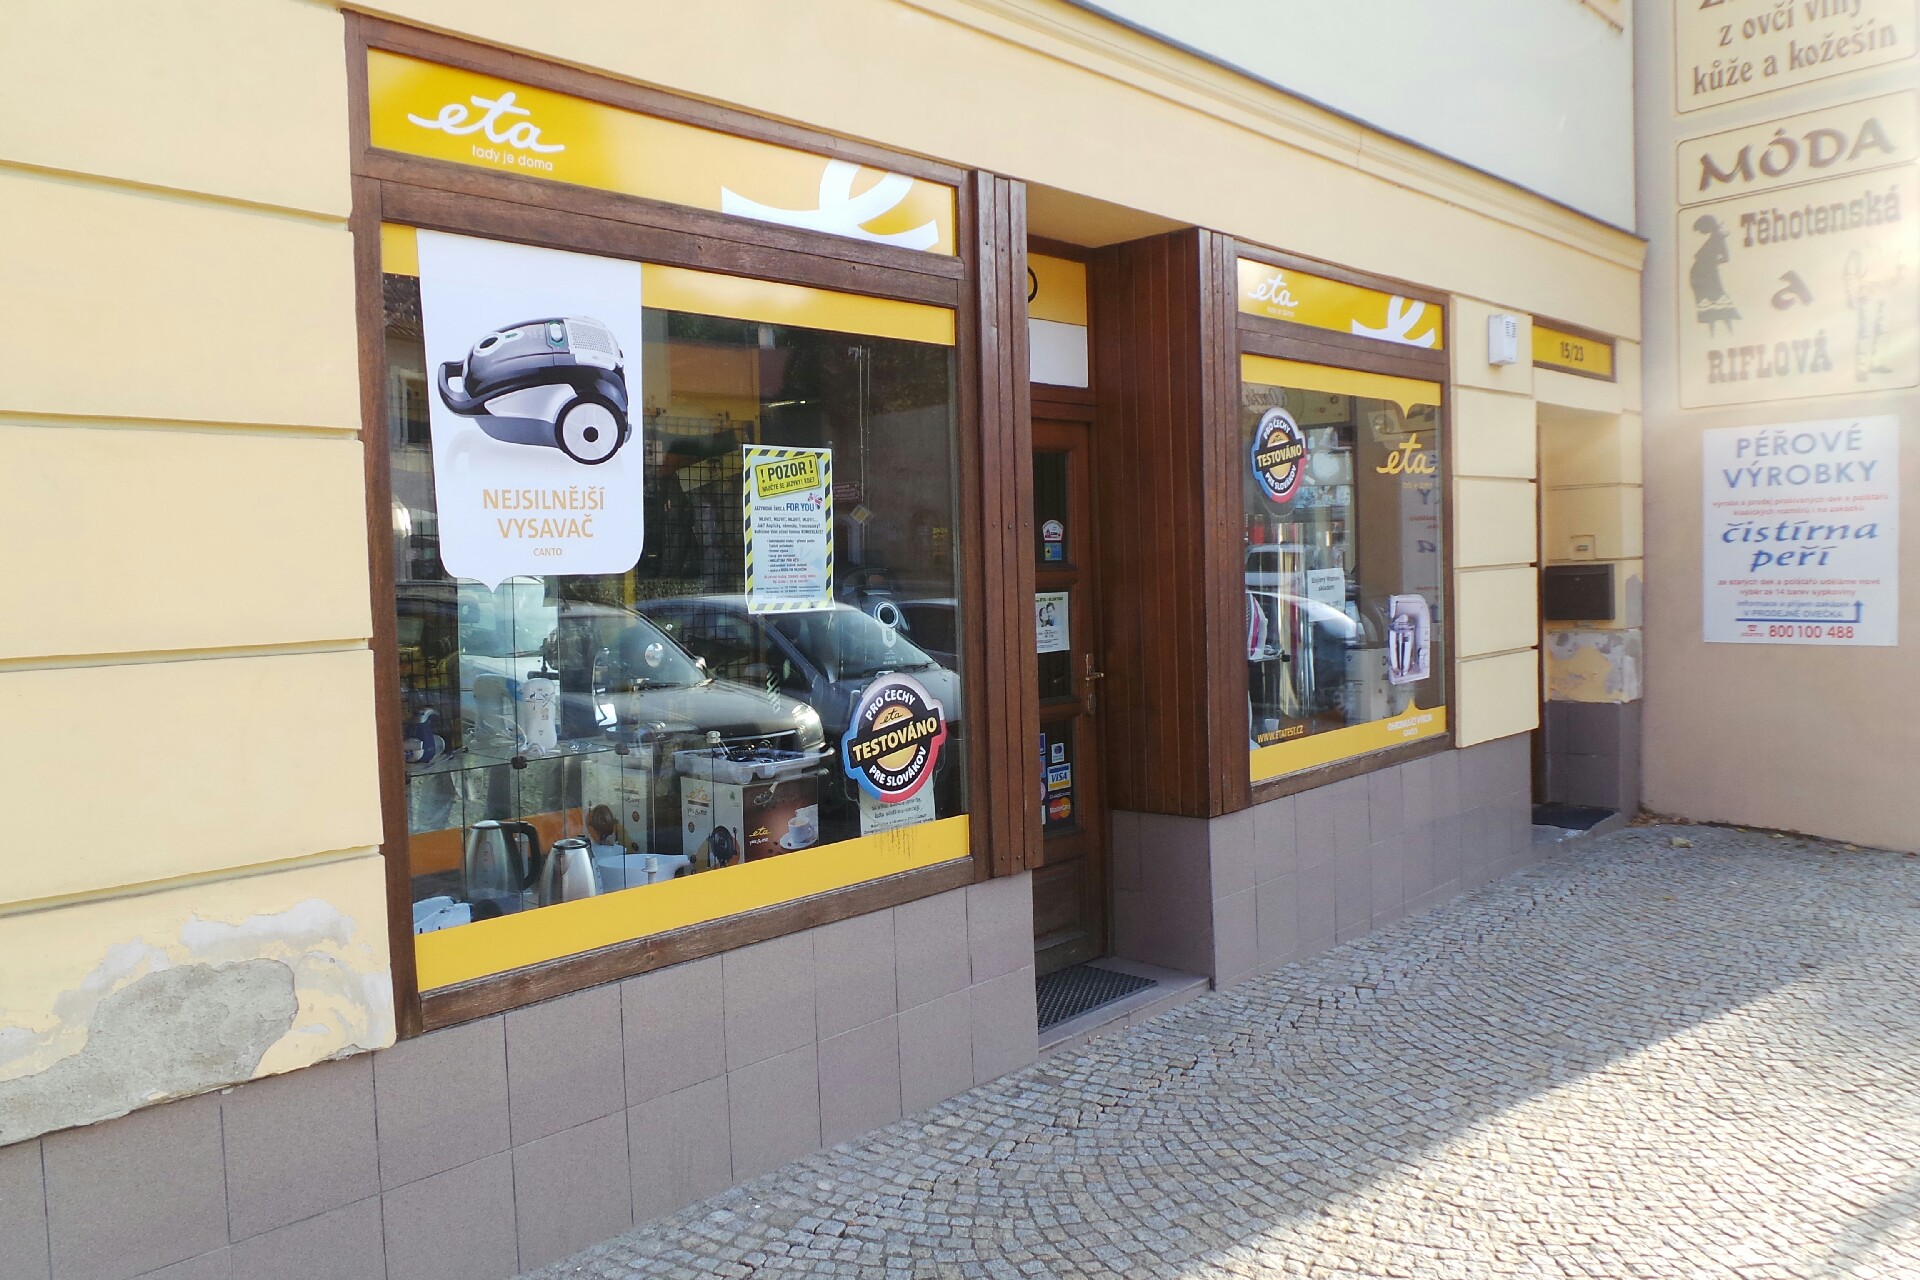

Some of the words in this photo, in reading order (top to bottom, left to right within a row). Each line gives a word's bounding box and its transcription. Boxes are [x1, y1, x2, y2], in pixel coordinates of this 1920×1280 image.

[1719, 23, 1734, 47] z
[1742, 0, 1795, 40] ovčí
[1692, 56, 1754, 96] kůže
[1763, 54, 1780, 77] a
[407, 92, 566, 153] eta
[472, 144, 500, 163] tady
[502, 151, 515, 165] je
[517, 154, 554, 171] doma
[1699, 117, 1898, 192] MÓDA
[1739, 183, 1903, 248] Těhotenská
[1247, 273, 1299, 307] eta
[1770, 270, 1814, 311] a
[1560, 341, 1584, 362] 15/23
[1707, 328, 1833, 384] RIFLOVÁ
[1264, 422, 1274, 440] PRO
[1736, 422, 1863, 459] PÉŘOVÉ
[1256, 444, 1303, 468] TESTOVÁNO
[1376, 433, 1436, 475] eta
[767, 461, 807, 482] POZOR
[1722, 459, 1878, 489] VÝROBKY
[482, 485, 605, 510] NEJSILNĚJŠÍ
[786, 502, 801, 512] FOR
[801, 502, 815, 512] YOU
[497, 513, 593, 539] VYSAVAČ
[1722, 520, 1880, 543] čistírna
[533, 548, 563, 557] CANTO
[1750, 545, 1838, 573] peří
[1768, 625, 1794, 638] 800
[1795, 625, 1821, 639] 100
[1827, 625, 1854, 639] 488
[865, 696, 885, 721] PRO
[884, 689, 916, 706] ČECHY
[880, 709, 904, 725] eta
[852, 716, 938, 763] TESTOVÁNO
[1257, 724, 1304, 744] WWW.ETATEST.CZ
[868, 764, 886, 786] PRE
[886, 746, 927, 787] SLOVÁKOV
[1051, 771, 1068, 783] VISA
[686, 785, 712, 802] eta
[749, 826, 771, 838] eta
